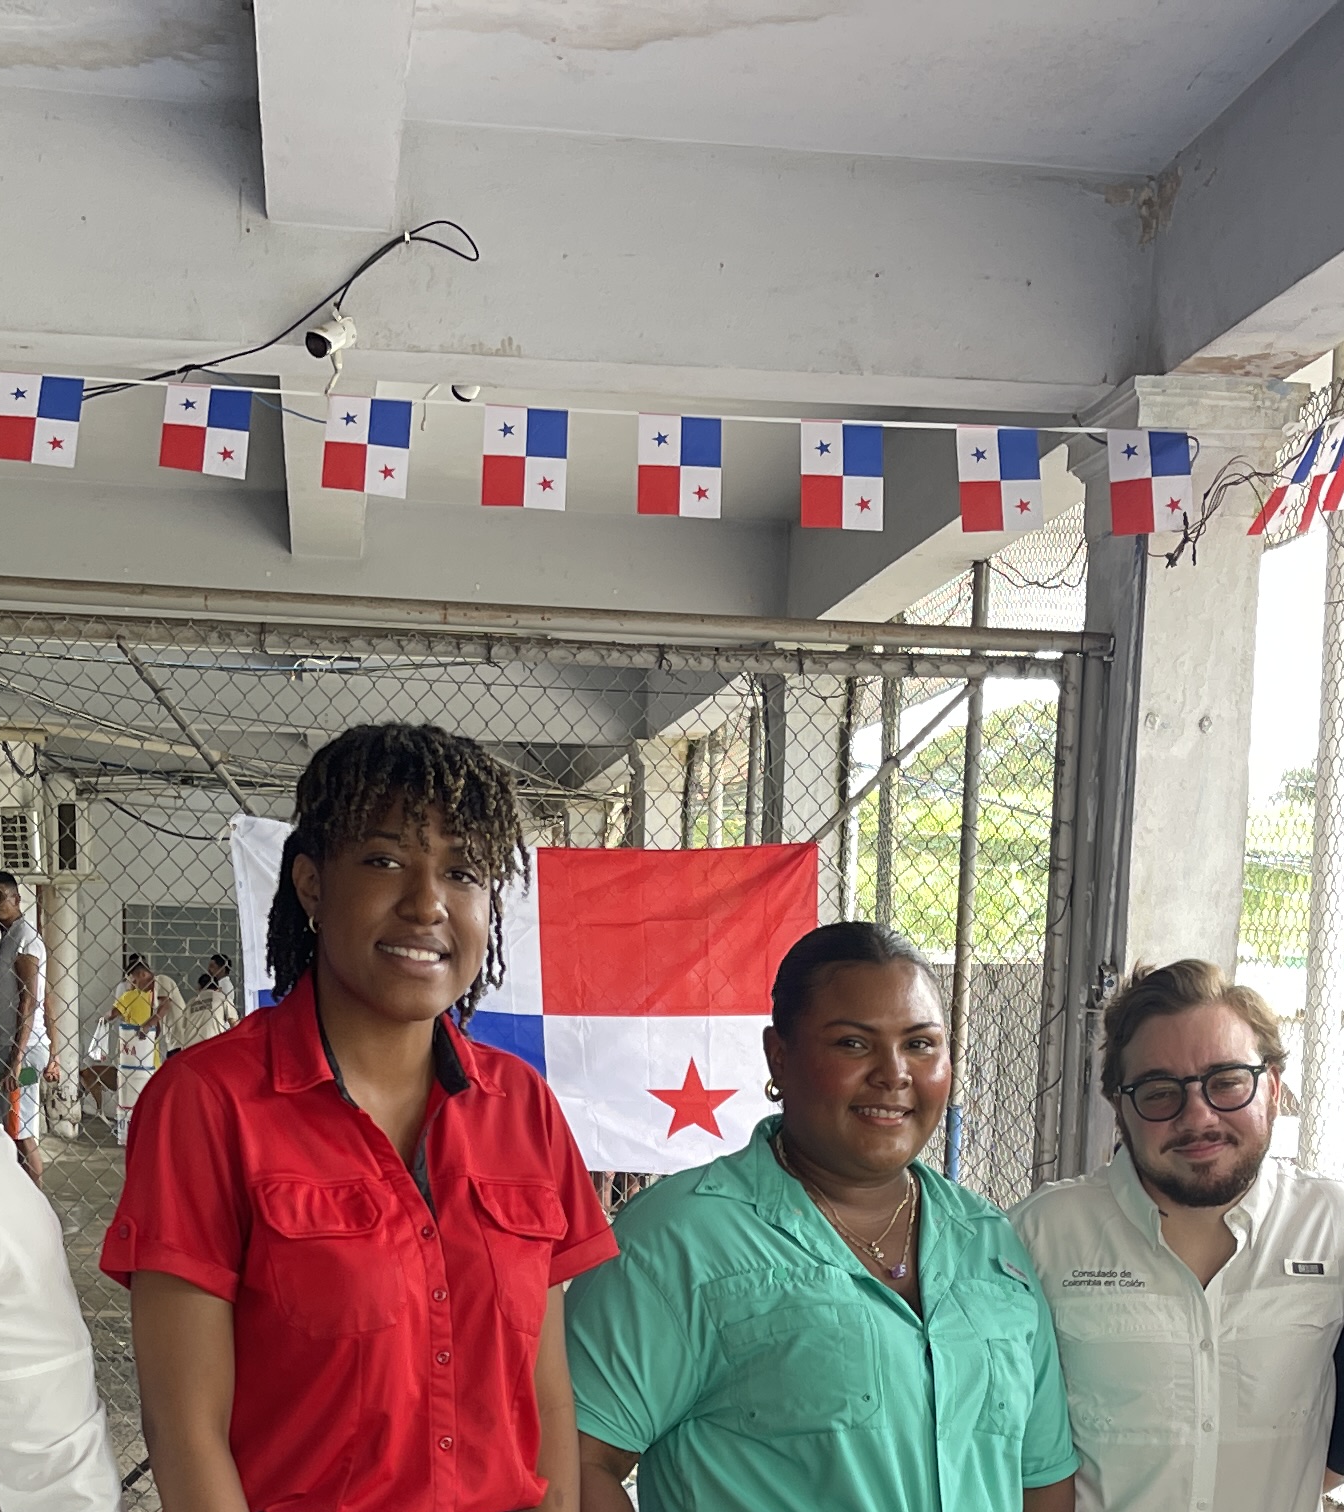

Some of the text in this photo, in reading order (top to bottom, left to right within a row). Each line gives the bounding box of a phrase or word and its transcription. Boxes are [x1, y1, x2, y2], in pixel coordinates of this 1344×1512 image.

[1071, 1269, 1132, 1278] Consulado de
[1062, 1278, 1145, 1288] Colombia en Colón
